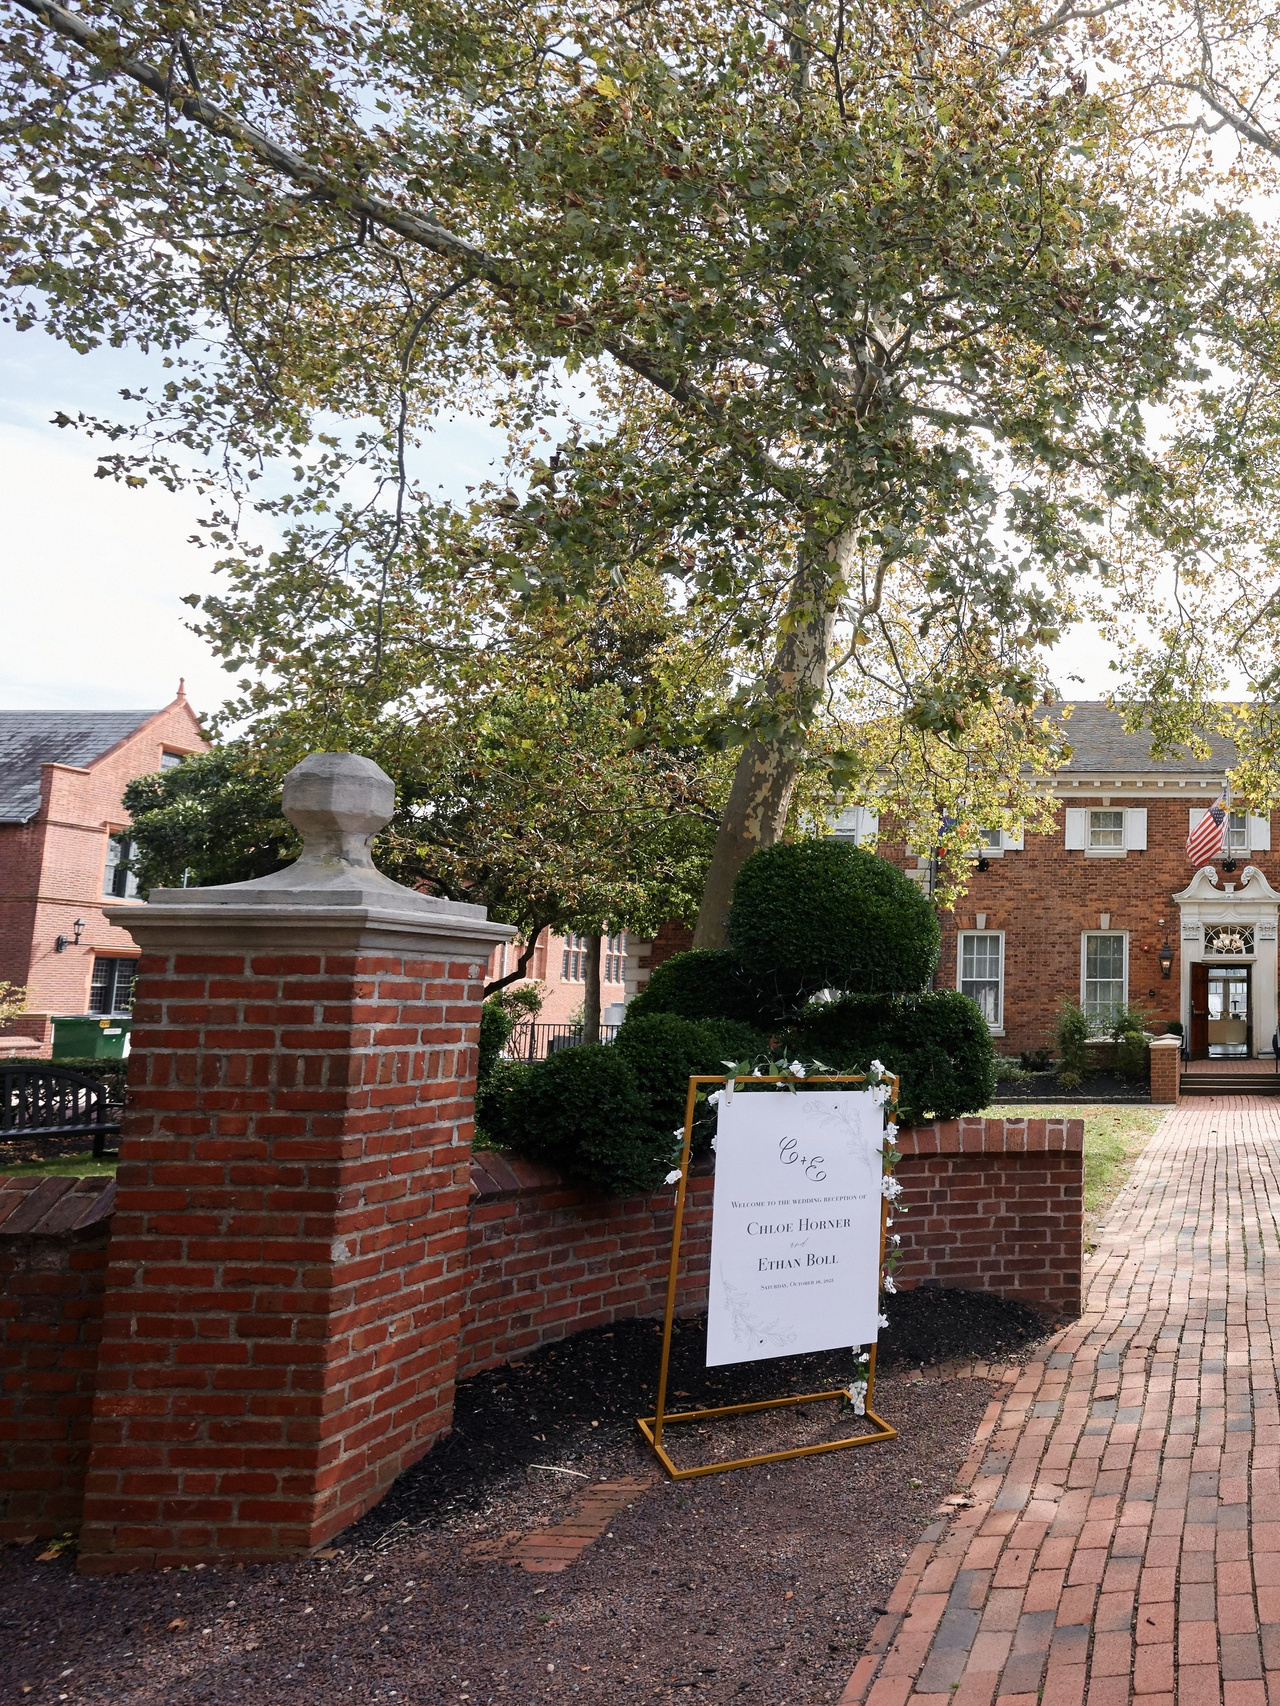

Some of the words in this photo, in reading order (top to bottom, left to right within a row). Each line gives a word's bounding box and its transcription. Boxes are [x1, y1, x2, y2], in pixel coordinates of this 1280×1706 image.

[779, 1136, 799, 1165] C
[805, 1156, 827, 1182] E
[746, 1221, 794, 1236] CHLOE
[798, 1218, 851, 1232] HORNER
[790, 1237, 809, 1249] and
[757, 1257, 801, 1271] ETHAN
[806, 1253, 839, 1267] BOLL
